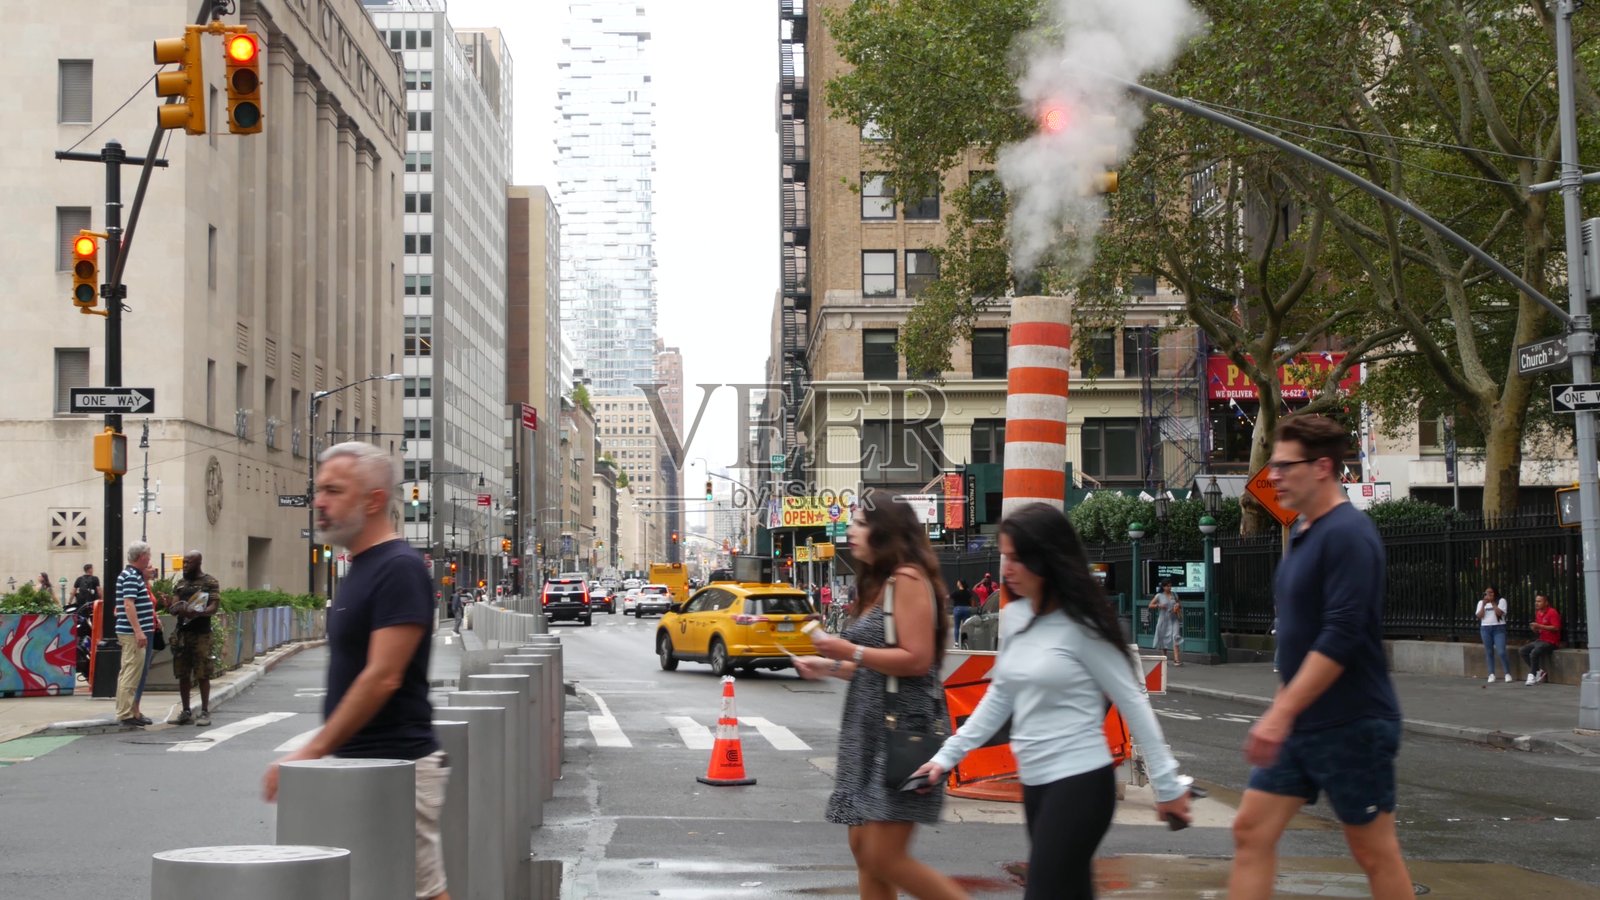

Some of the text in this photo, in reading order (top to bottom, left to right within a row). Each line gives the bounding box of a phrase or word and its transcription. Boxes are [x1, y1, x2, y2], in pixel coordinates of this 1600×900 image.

[1521, 350, 1547, 369] Church
[1216, 390, 1225, 398] WE
[1226, 390, 1253, 398] DELIVER
[1564, 392, 1586, 404] ONE
[82, 395, 142, 406] ONE WAY
[784, 510, 815, 526] OPEN
